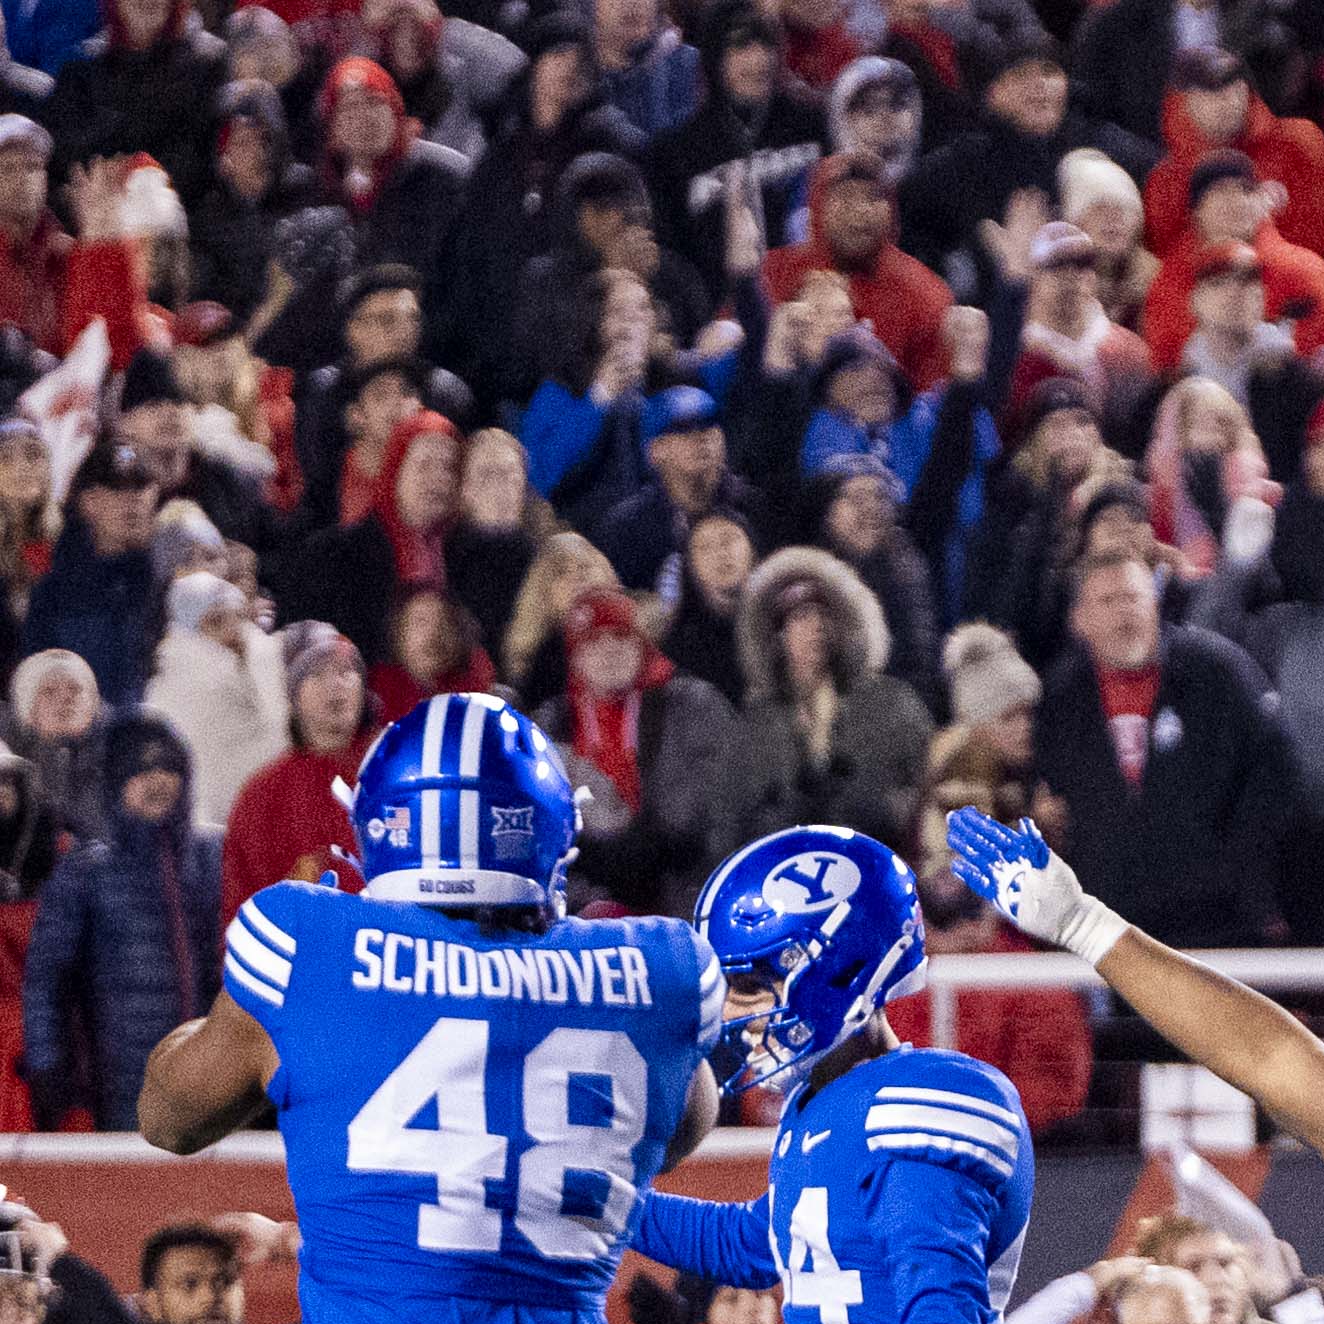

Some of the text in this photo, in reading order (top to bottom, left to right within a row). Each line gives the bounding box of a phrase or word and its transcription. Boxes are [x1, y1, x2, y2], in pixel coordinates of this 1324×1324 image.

[773, 857, 838, 904] Y
[352, 928, 652, 1007] SCHOONOVER
[347, 1017, 648, 1262] 48
